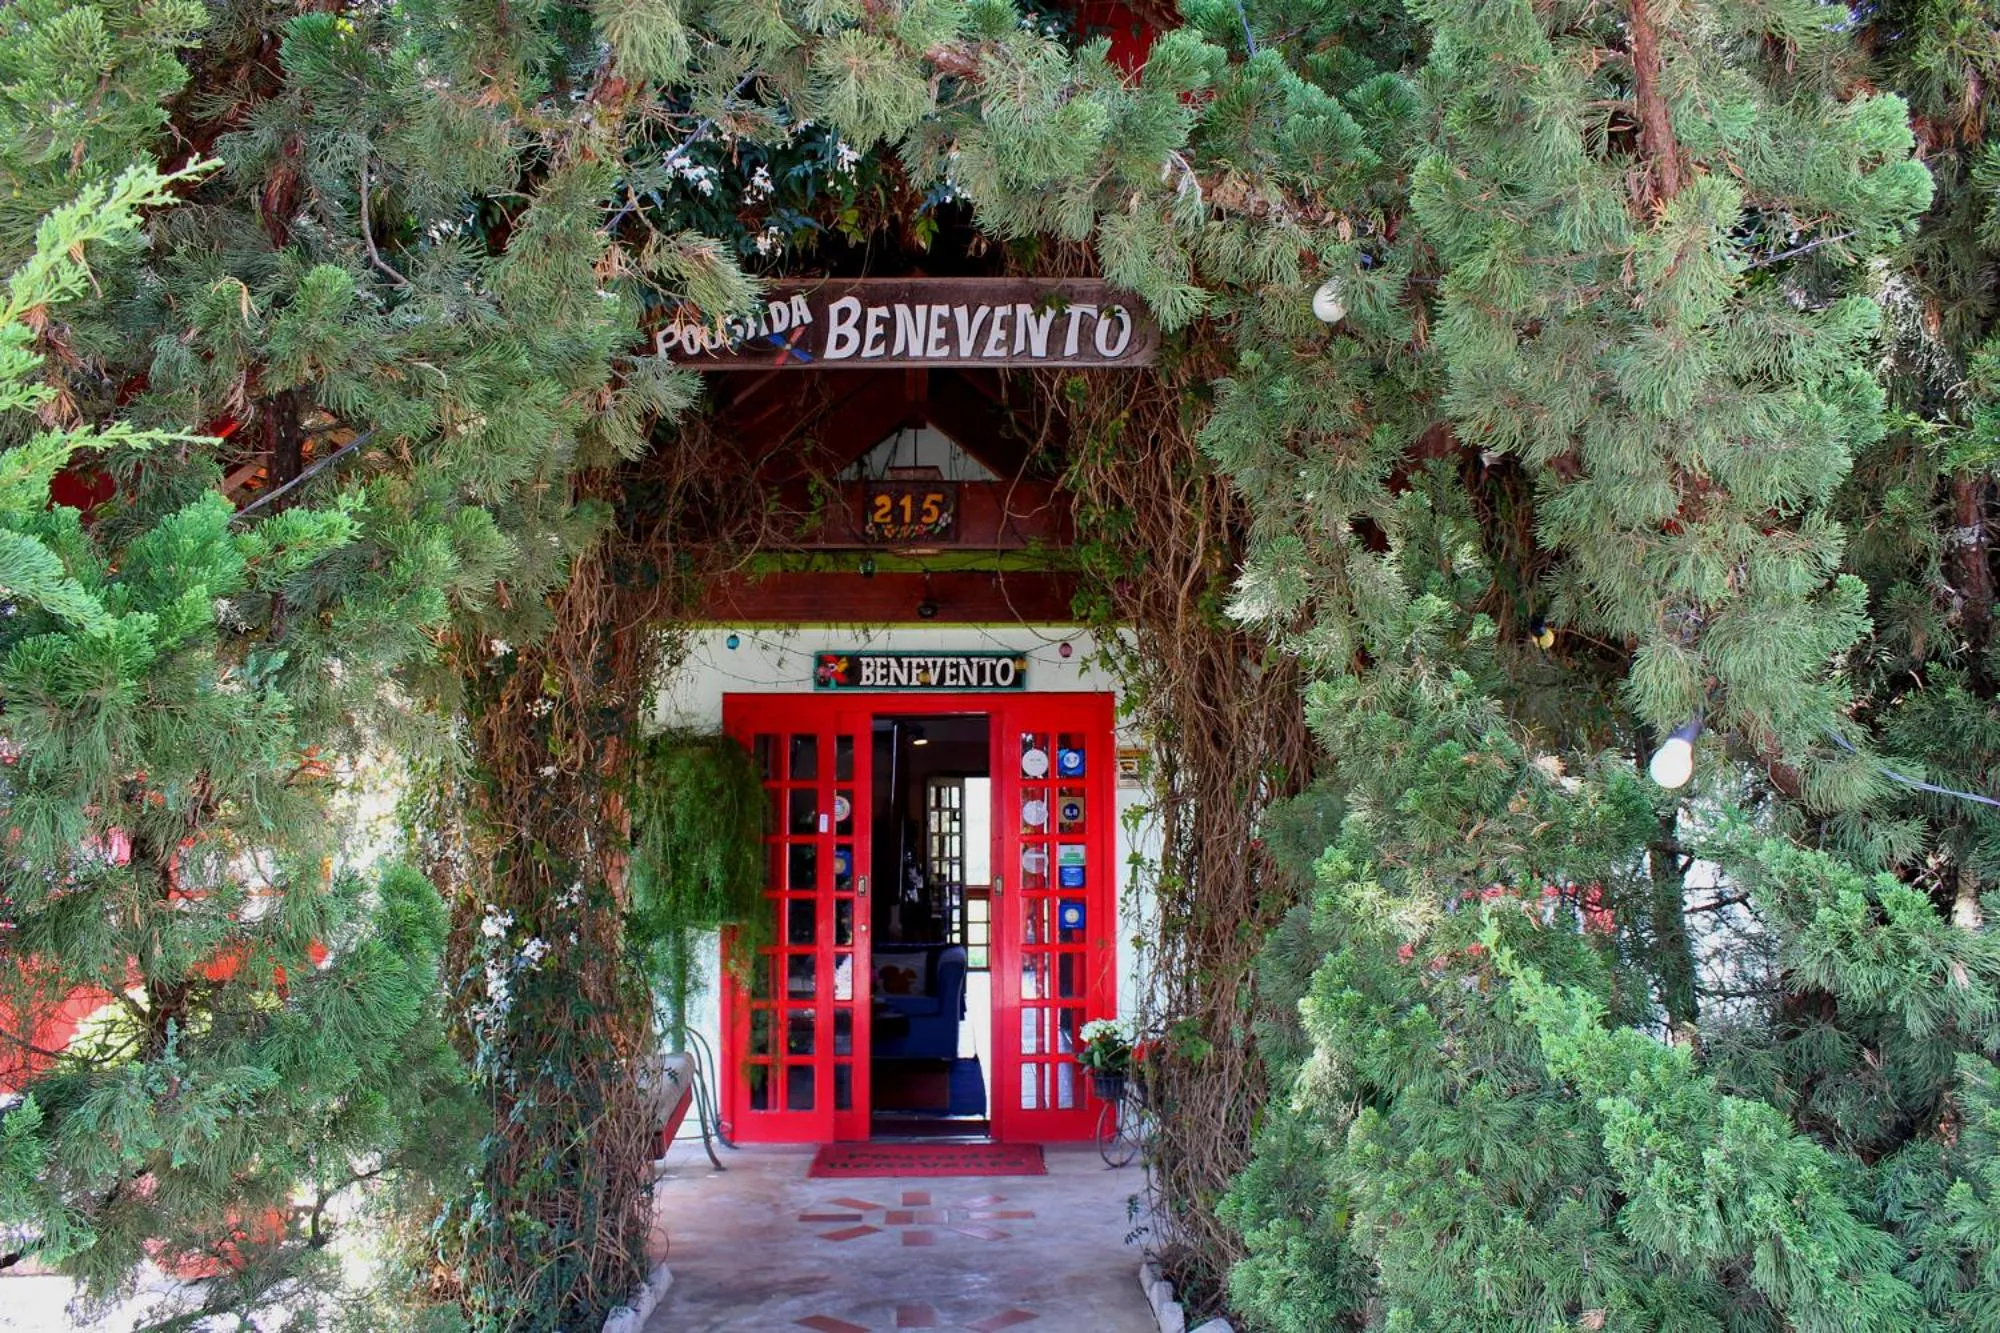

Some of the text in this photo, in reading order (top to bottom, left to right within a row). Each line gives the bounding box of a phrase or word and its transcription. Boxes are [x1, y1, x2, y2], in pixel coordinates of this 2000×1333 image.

[823, 296, 1132, 360] BENEVENTO
[872, 492, 944, 525] 215
[858, 656, 1017, 687] BENEVENTO
